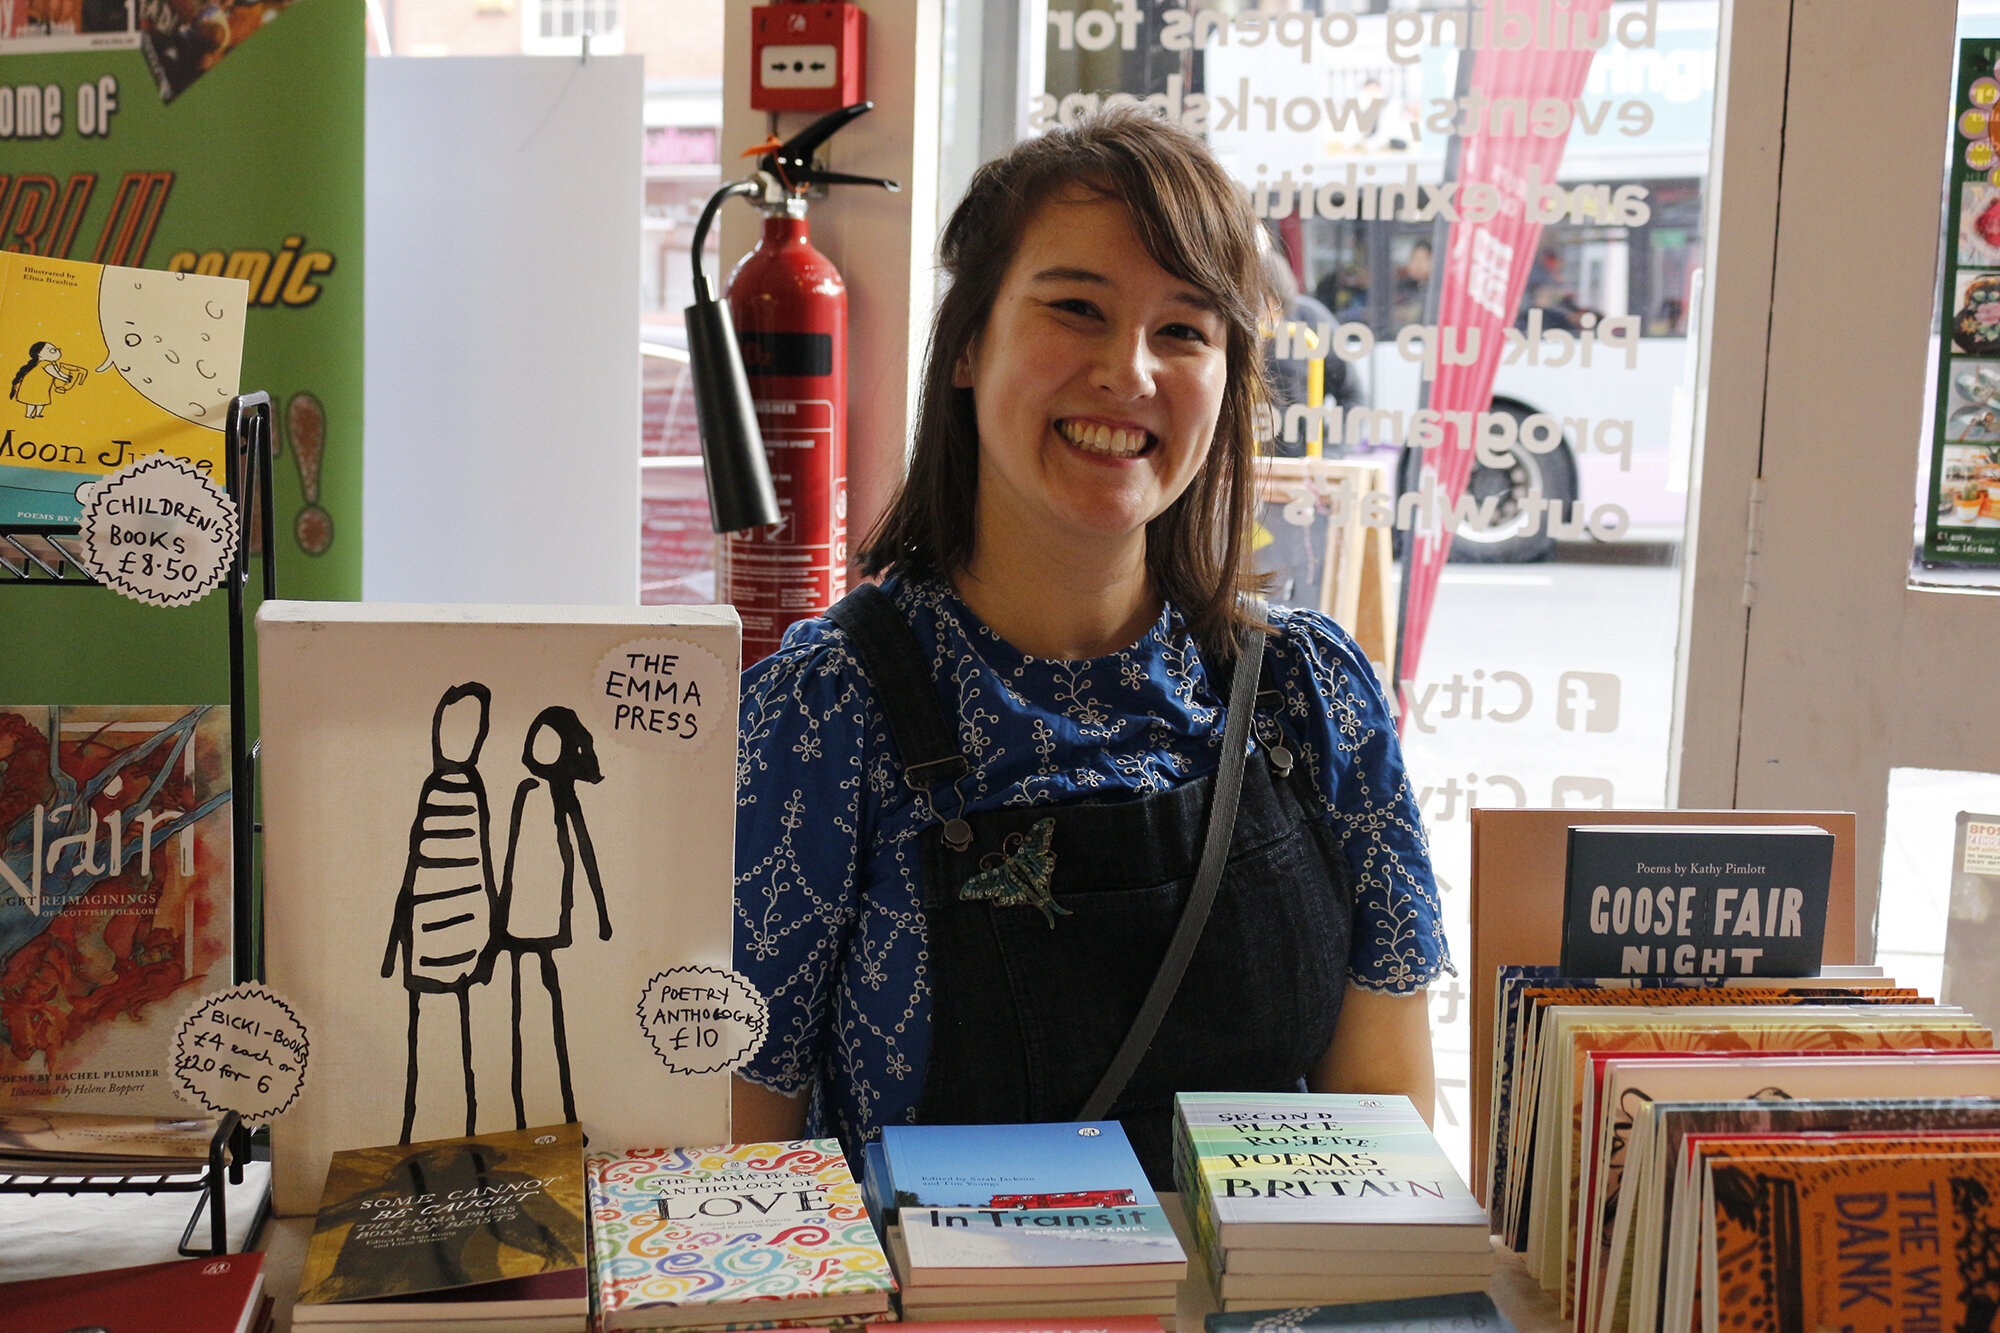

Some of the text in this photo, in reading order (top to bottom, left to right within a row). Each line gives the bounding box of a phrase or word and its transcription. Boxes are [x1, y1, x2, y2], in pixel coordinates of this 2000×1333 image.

[77, 74, 117, 137] of
[24, 266, 75, 280] Illustrated by
[17, 511, 54, 522] POEMS
[57, 515, 71, 523] BY
[106, 495, 224, 544] CHILDREN'S
[109, 523, 186, 554] BOOKS
[626, 653, 679, 676] THE
[605, 670, 702, 707] EMMA
[614, 703, 698, 740] PRESS
[1636, 862, 1767, 877] Poems by Kathy Pimlott
[42, 893, 157, 906] REIMAGININGS
[42, 907, 160, 919] OF SCOTTISH FOLKLORE
[1589, 885, 1804, 937] GOOSE FAIR
[1621, 943, 1764, 975] NIGHT
[661, 985, 729, 1004] POETRY
[669, 1026, 719, 1050] £10
[194, 1031, 296, 1072] £4 each or
[37, 1073, 52, 1082] BY
[56, 1071, 101, 1081] RACHEL
[103, 1069, 159, 1079] PLUMMER
[219, 1063, 251, 1081] for
[257, 1075, 273, 1094] 6
[10, 1082, 145, 1098] Illustrated by Helene Boppert
[1217, 1111, 1334, 1122] SECOND
[1232, 1121, 1344, 1133] PLACE
[1240, 1135, 1378, 1148] ROSETTE:
[1222, 1152, 1379, 1168] POEMS
[655, 1171, 813, 1187] THE EMMA PRESS
[1291, 1167, 1388, 1177] ABOUT
[359, 1175, 563, 1210] SOME CANNOT
[658, 1180, 815, 1196] ANTHOLOGY OF
[1219, 1178, 1445, 1200] BRITAIN
[371, 1190, 540, 1221] BE CAUGHT
[649, 1189, 836, 1222] LOVE
[356, 1205, 517, 1232] THE EMMA PRESS
[930, 1208, 1147, 1228] In Transit
[1897, 1180, 1940, 1255] THE
[355, 1226, 408, 1240] BOOK
[1025, 1228, 1071, 1236] POEMS
[1094, 1225, 1150, 1234] TRAVEL
[1834, 1191, 1893, 1311] DANK
